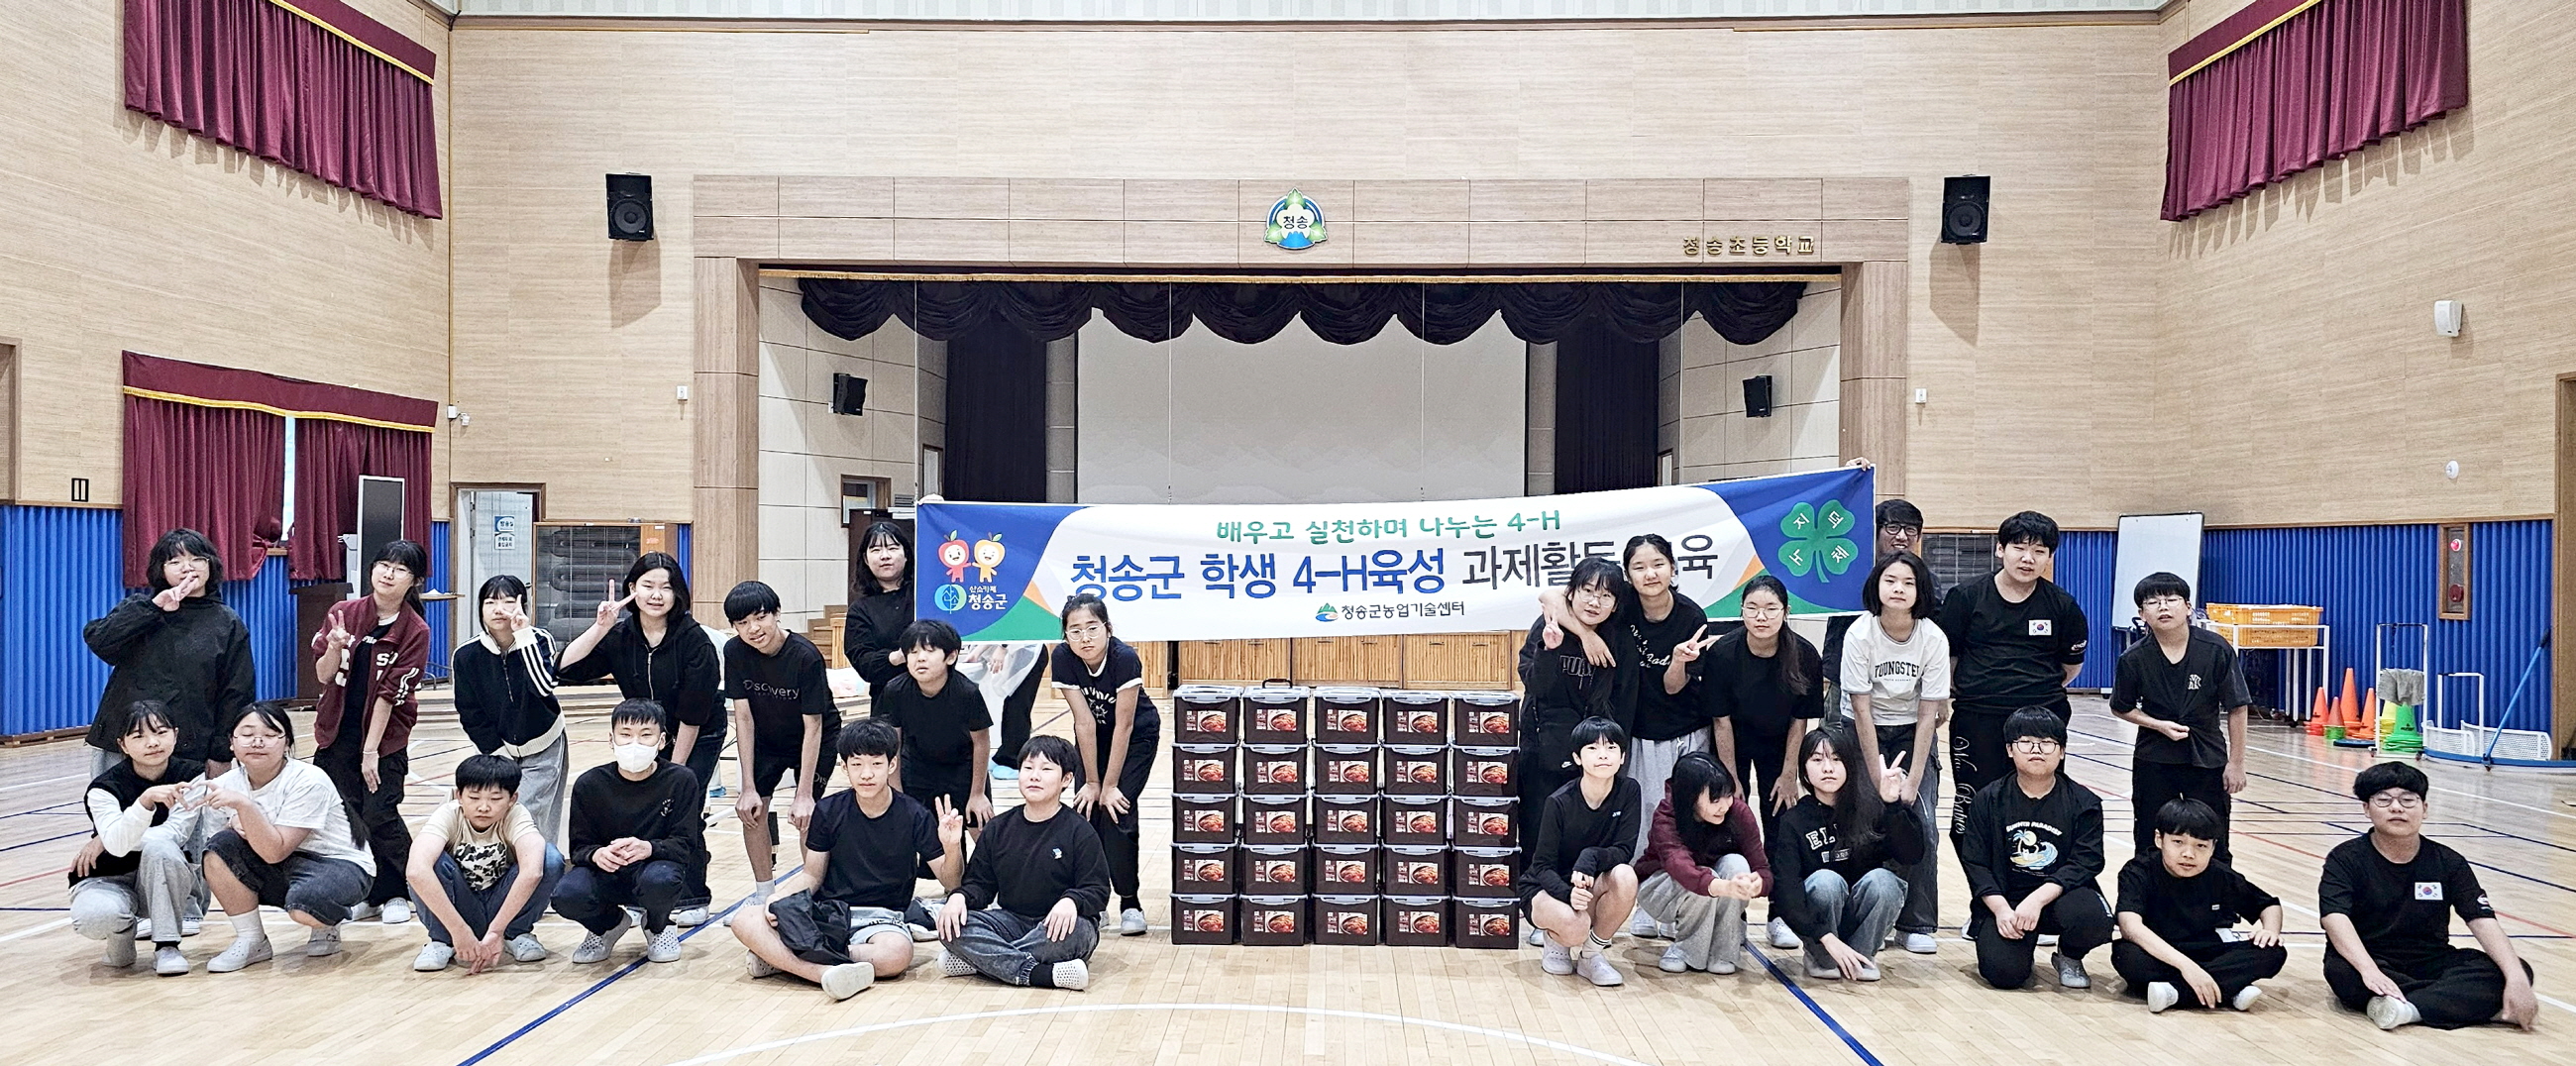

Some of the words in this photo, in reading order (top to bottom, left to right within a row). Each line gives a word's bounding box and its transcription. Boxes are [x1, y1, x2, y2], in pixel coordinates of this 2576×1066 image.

[1282, 215, 1309, 230] 청송
[1682, 235, 1815, 256] 청송초등학교
[1217, 520, 1295, 544] 배우고
[1305, 518, 1407, 545] 실천하며
[1419, 514, 1498, 539] 나누는
[1507, 509, 1560, 532] 4-H
[1792, 512, 1810, 530] 지
[1827, 510, 1844, 529] 덕
[1788, 548, 1803, 567] 노
[1830, 544, 1850, 564] 체
[1070, 554, 1185, 602] 청송군
[1200, 552, 1277, 599] 학생
[1293, 547, 1446, 594] 4-H육성
[968, 593, 1009, 611] 청송군
[1341, 600, 1465, 621] 청송군농업기술센터
